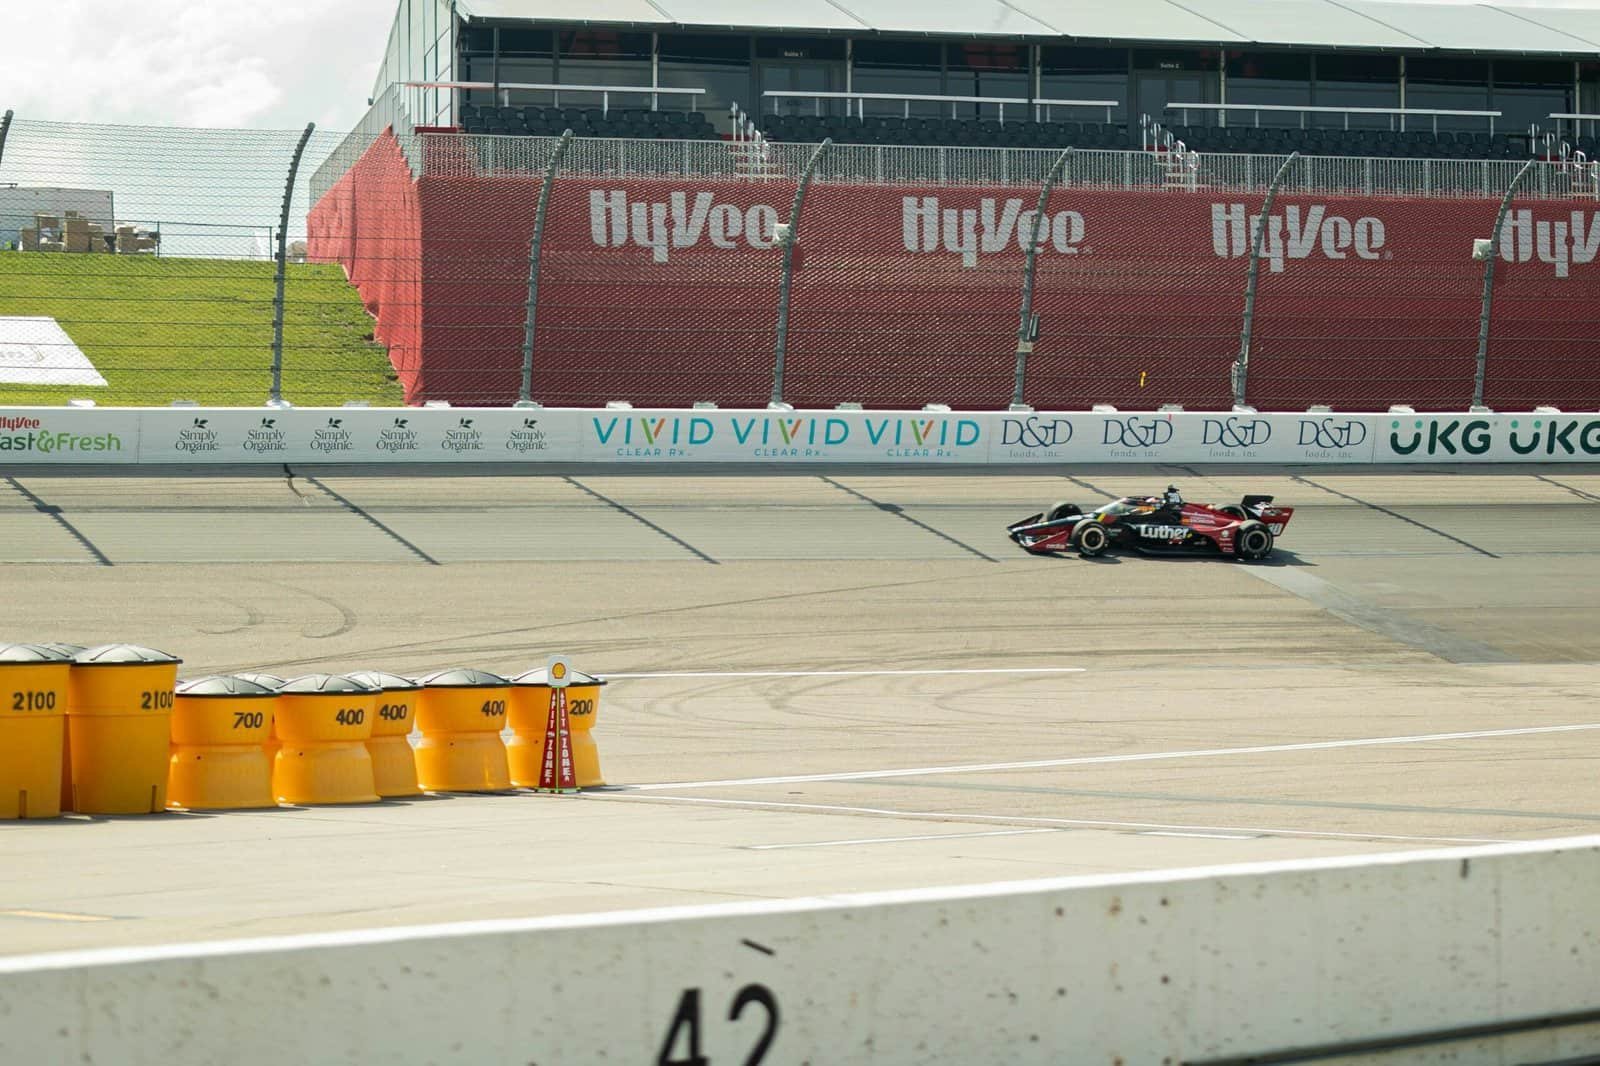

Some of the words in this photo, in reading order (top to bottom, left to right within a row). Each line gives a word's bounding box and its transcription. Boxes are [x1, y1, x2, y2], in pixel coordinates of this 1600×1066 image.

[589, 190, 779, 263] HyVee
[902, 197, 1085, 268] HyVee
[1211, 203, 1385, 273] HyVee
[179, 429, 218, 441] Simply
[248, 429, 286, 441] Simply
[314, 429, 351, 441] Simply
[380, 429, 417, 441] Simply
[445, 429, 482, 441] Simply
[509, 429, 546, 441] Simply
[593, 417, 714, 445] VIVID
[732, 417, 850, 445] VIVID
[865, 419, 980, 447] VIVID
[1001, 416, 1073, 447] D&D
[1101, 416, 1173, 447] D&D
[1201, 416, 1272, 447] D&D
[1298, 418, 1367, 449] D&D
[0, 430, 121, 453] ast&Fresh
[175, 440, 218, 453] Organic
[243, 440, 285, 453] Organic
[310, 440, 352, 453] Organic
[376, 440, 417, 453] Organic
[441, 440, 482, 453] Organic
[505, 440, 546, 453] Organic
[617, 448, 661, 457] CLEAR
[754, 448, 798, 457] CLEAR
[887, 448, 929, 457] CLEAR
[13, 691, 55, 711] 2100
[141, 691, 173, 710] 2100
[481, 700, 505, 717] 400
[569, 699, 593, 716] 200
[233, 712, 263, 729] 700
[336, 708, 364, 725] 400
[379, 704, 407, 720] 400
[544, 739, 553, 778] ZONE
[561, 738, 571, 776] ZONE
[656, 981, 780, 1066] 42
